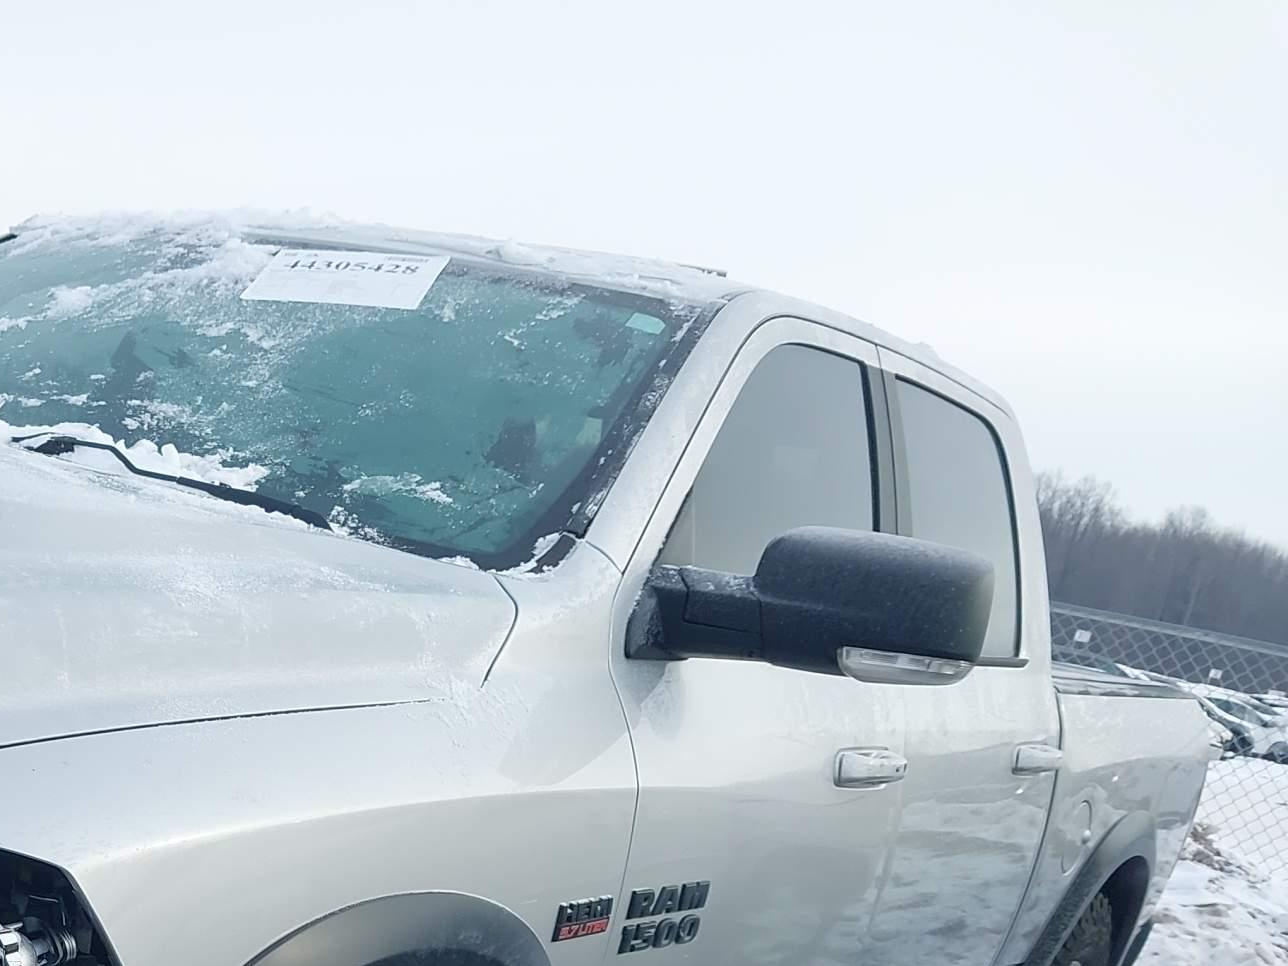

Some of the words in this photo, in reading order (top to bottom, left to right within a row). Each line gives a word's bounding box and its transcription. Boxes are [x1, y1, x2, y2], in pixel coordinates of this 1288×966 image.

[283, 259, 420, 275] 44305428
[557, 894, 614, 925] HEMI
[625, 880, 711, 921] RAM
[577, 918, 609, 937] LITER
[617, 914, 701, 955] 1500
